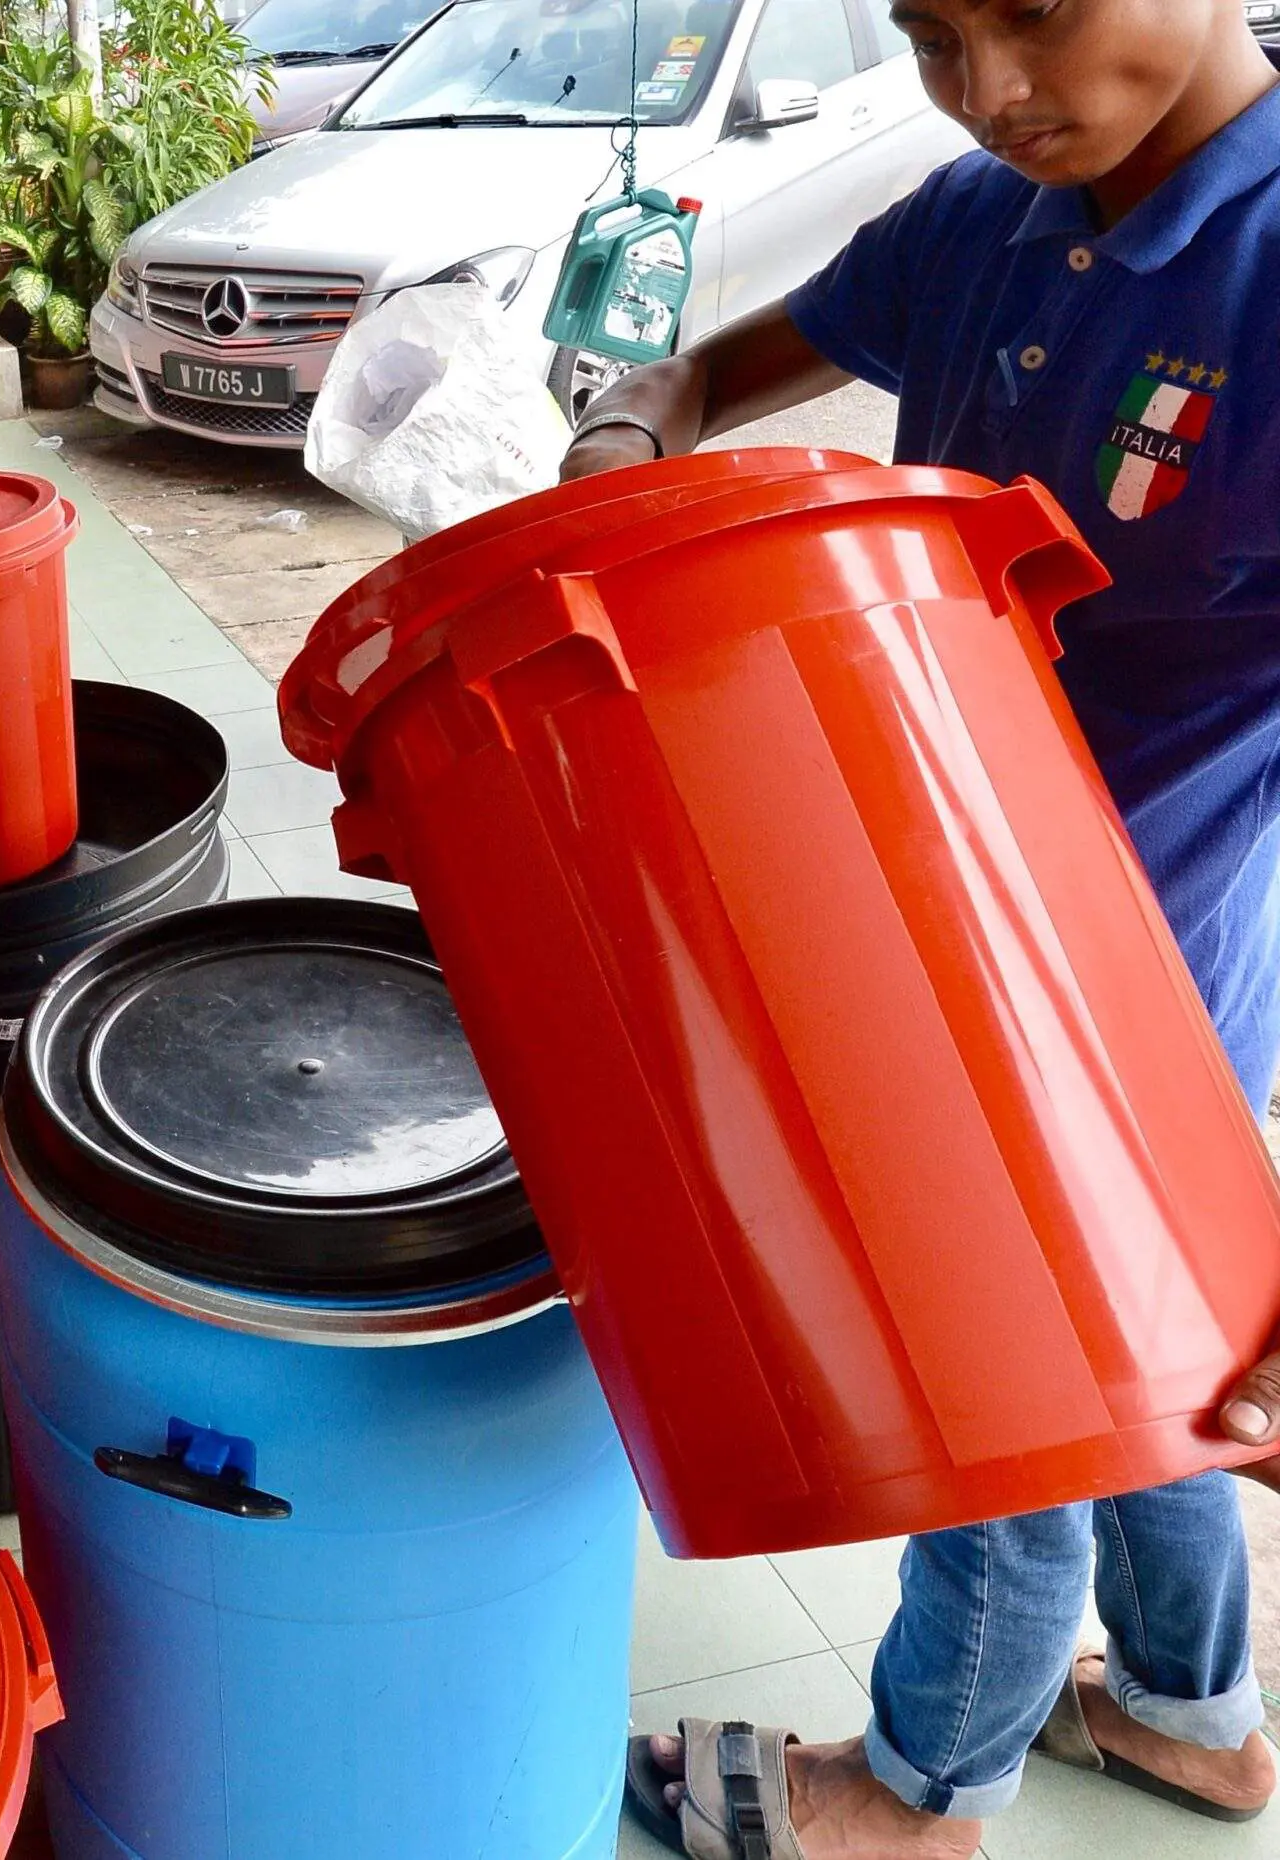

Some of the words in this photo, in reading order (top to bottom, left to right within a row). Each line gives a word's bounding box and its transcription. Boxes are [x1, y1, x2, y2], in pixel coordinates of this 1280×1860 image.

[194, 366, 244, 396] 7765
[250, 371, 263, 397] J
[1111, 425, 1181, 464] ITALIA
